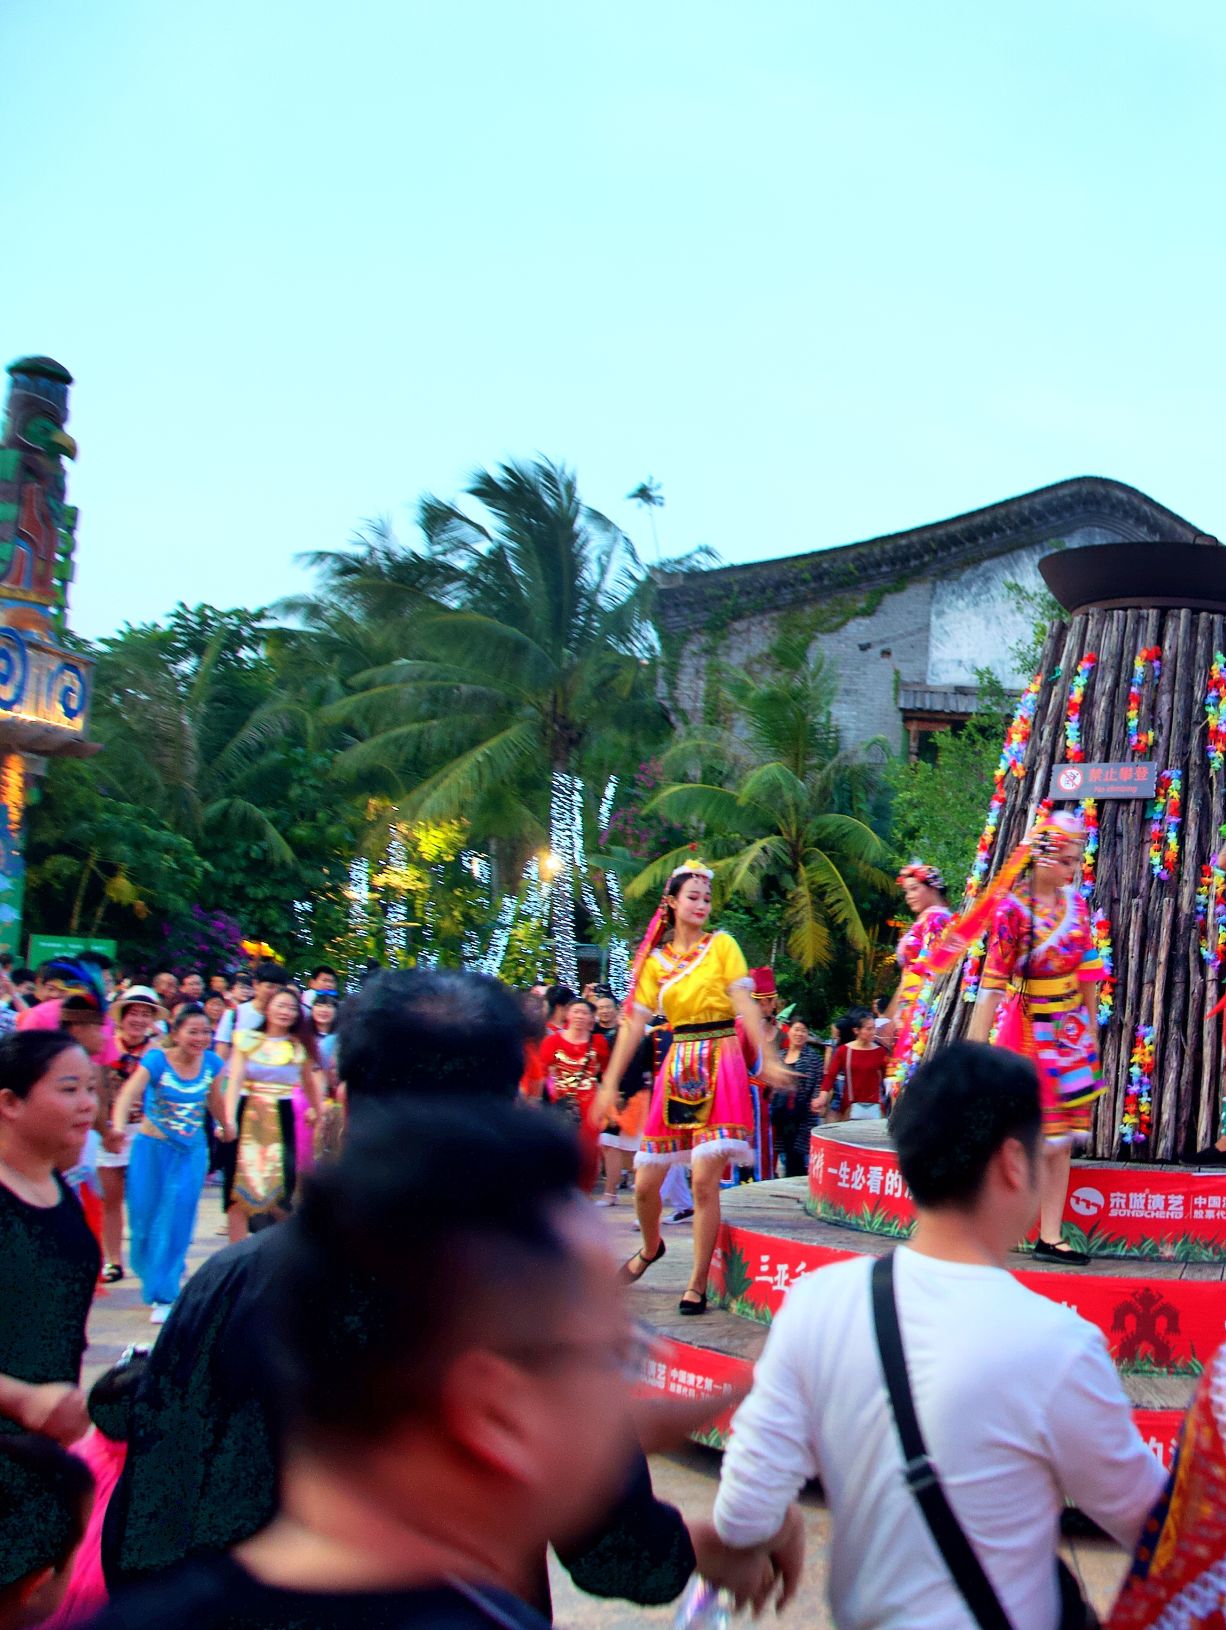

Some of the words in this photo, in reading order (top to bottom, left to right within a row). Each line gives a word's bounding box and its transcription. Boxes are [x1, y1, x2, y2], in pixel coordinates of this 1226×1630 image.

[1109, 1192, 1184, 1211] 宋城演艺
[1108, 1209, 1184, 1219] SONGCHENG
